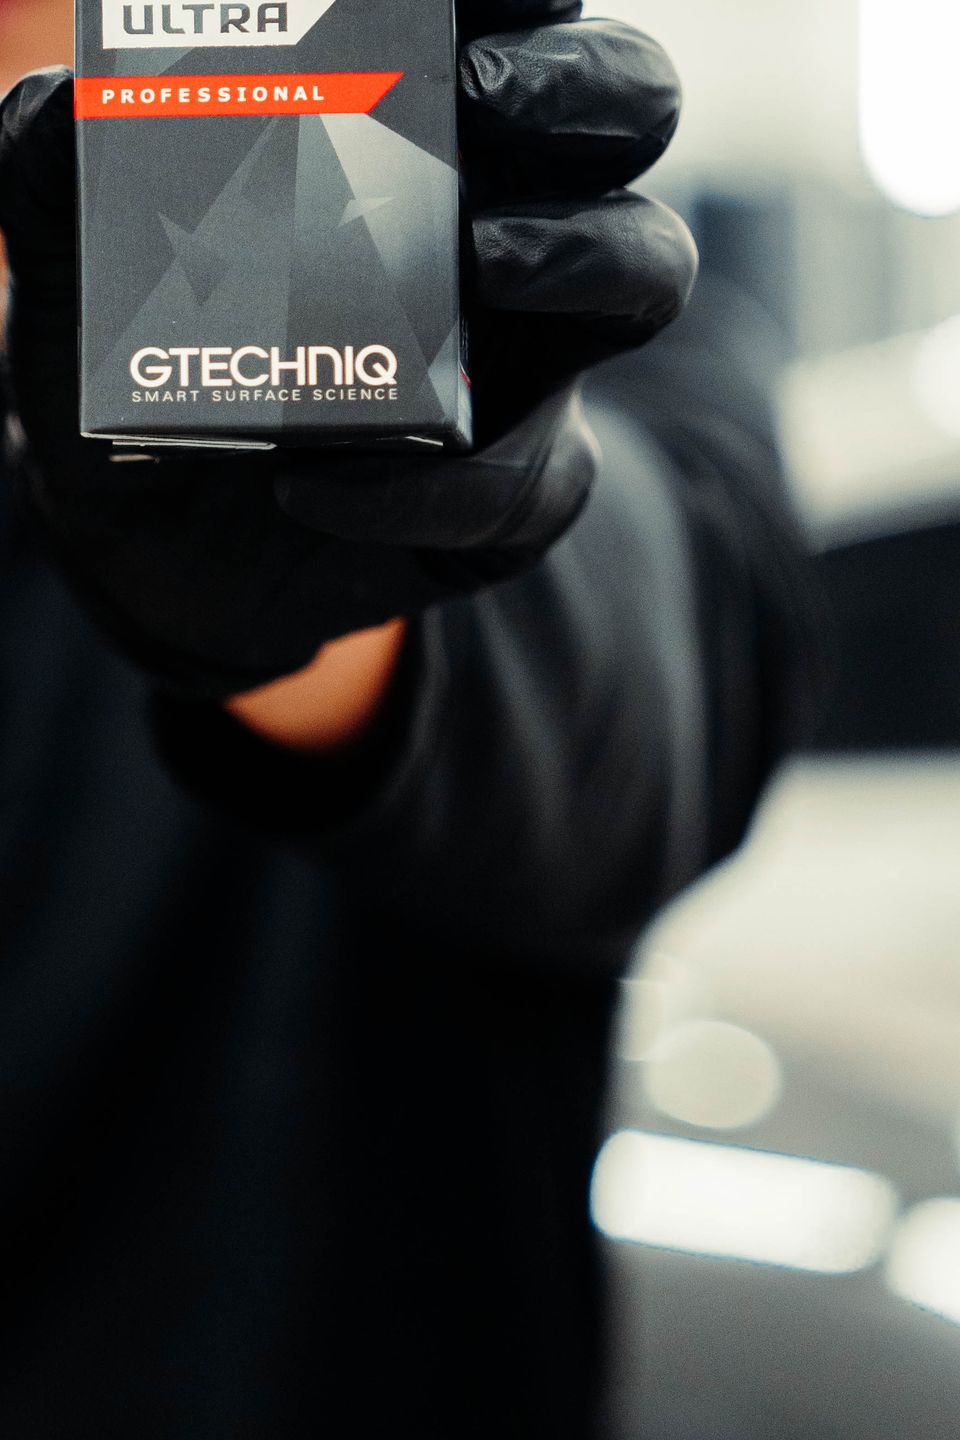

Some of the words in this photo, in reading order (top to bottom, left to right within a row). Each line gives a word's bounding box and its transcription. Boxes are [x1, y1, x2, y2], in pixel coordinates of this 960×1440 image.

[122, 1, 288, 35] ULTRA
[102, 86, 325, 104] PROFESSIONAL
[129, 344, 398, 388] GTECHNIQ
[131, 390, 200, 403] SMART
[212, 389, 302, 402] SURFACE
[313, 388, 398, 401] SCIENCE
